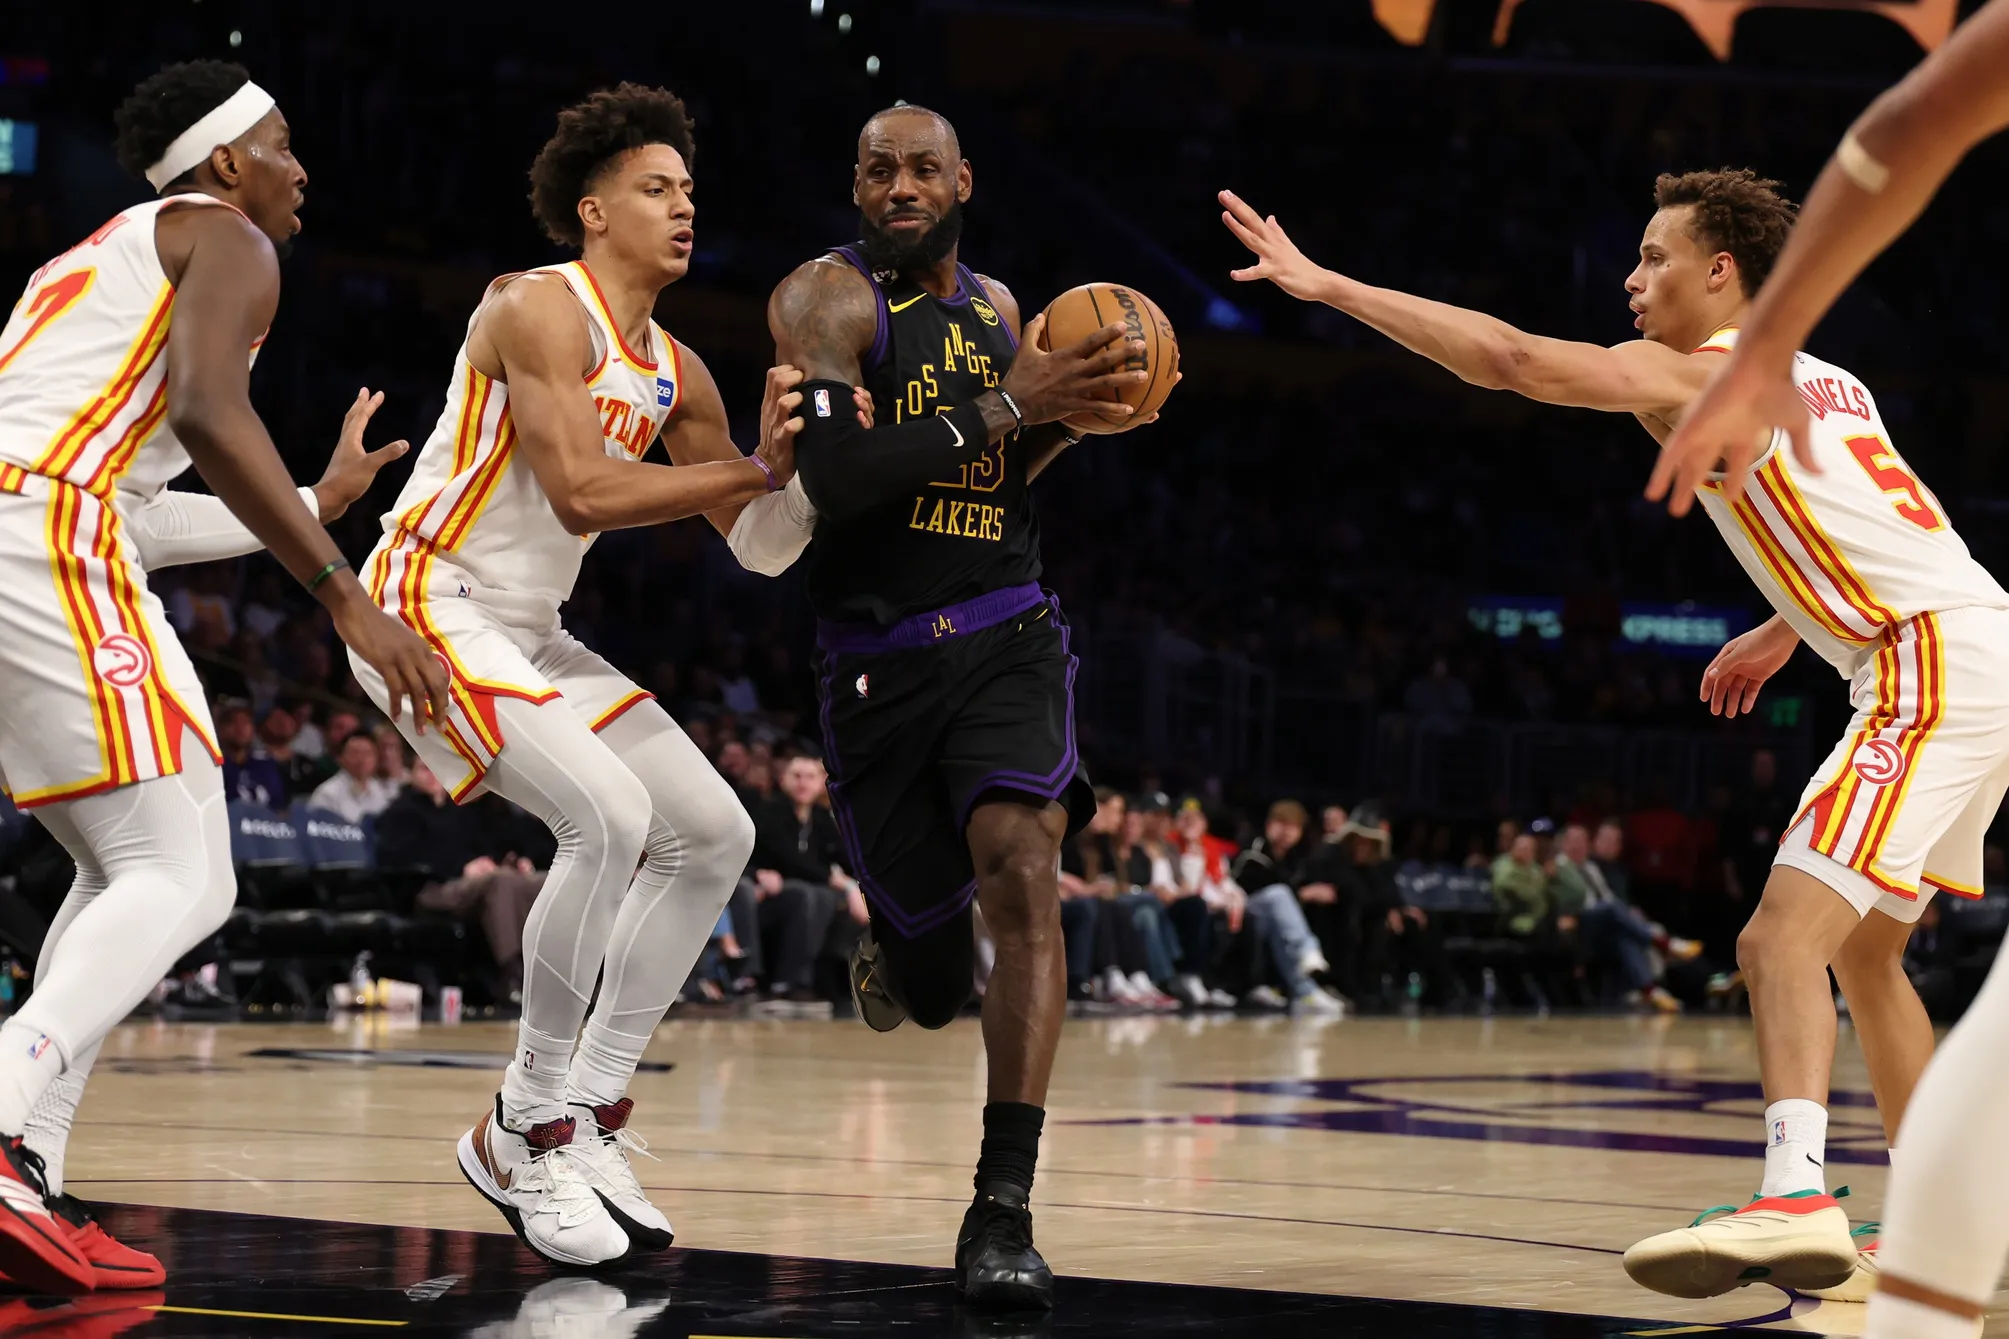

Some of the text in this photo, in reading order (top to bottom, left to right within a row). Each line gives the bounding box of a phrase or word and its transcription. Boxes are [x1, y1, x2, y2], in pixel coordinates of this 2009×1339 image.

[0, 266, 97, 373] 7
[909, 496, 1005, 541] LAKERS
[1841, 433, 1947, 533] 5
[931, 614, 957, 638] LAL
